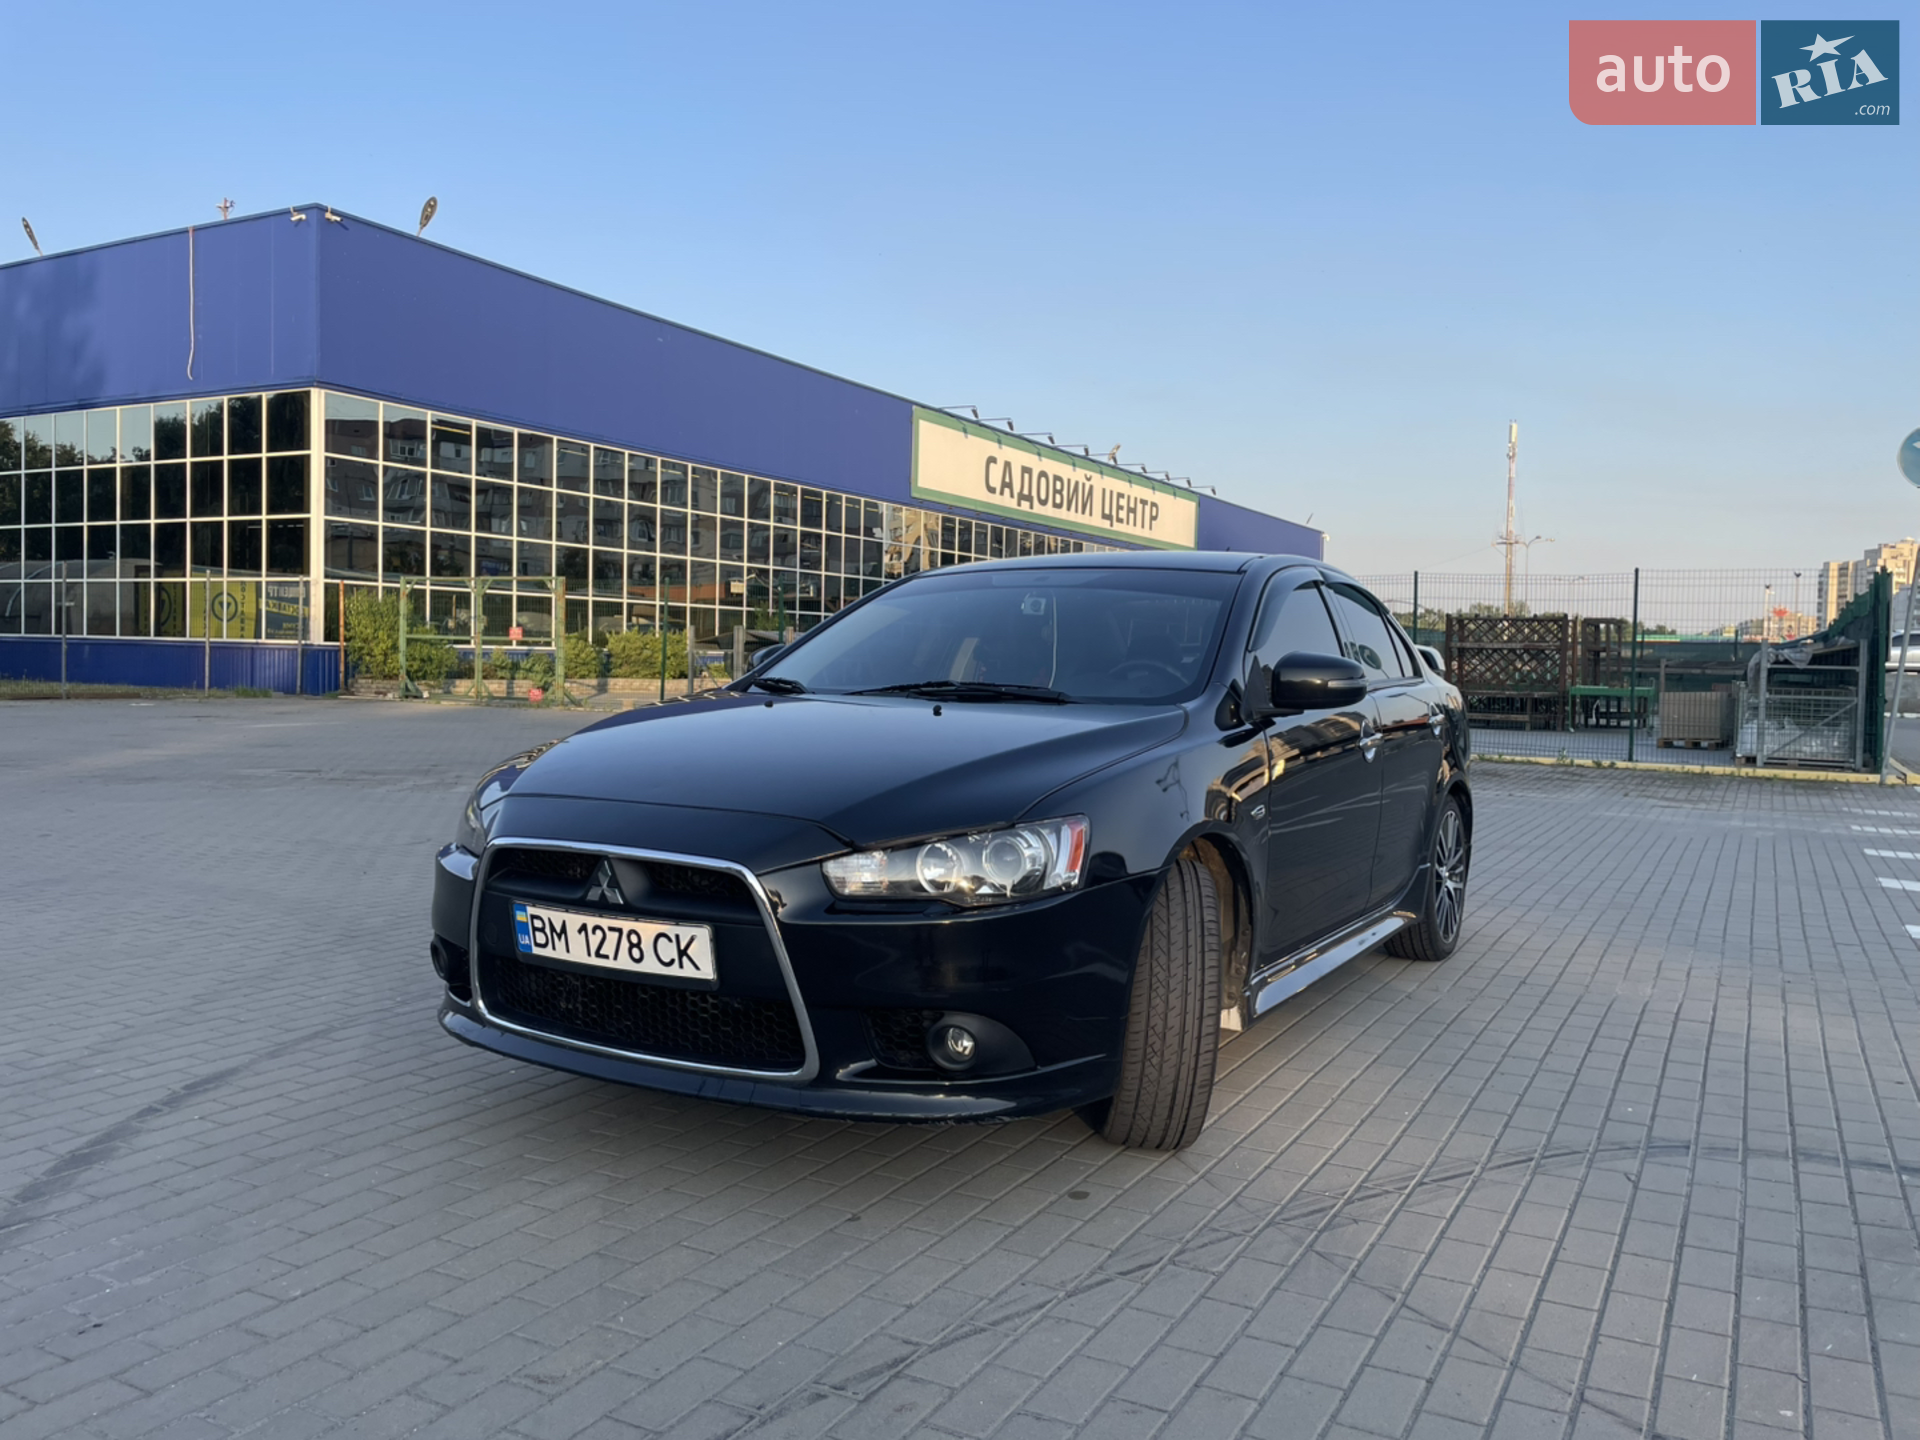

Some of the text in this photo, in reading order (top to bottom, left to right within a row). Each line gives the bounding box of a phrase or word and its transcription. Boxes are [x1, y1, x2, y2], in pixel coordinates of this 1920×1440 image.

[984, 455, 1160, 531] САДОВИЙ ЦЕНТР
[518, 933, 531, 945] UA
[529, 913, 702, 971] BM 1278 CK
